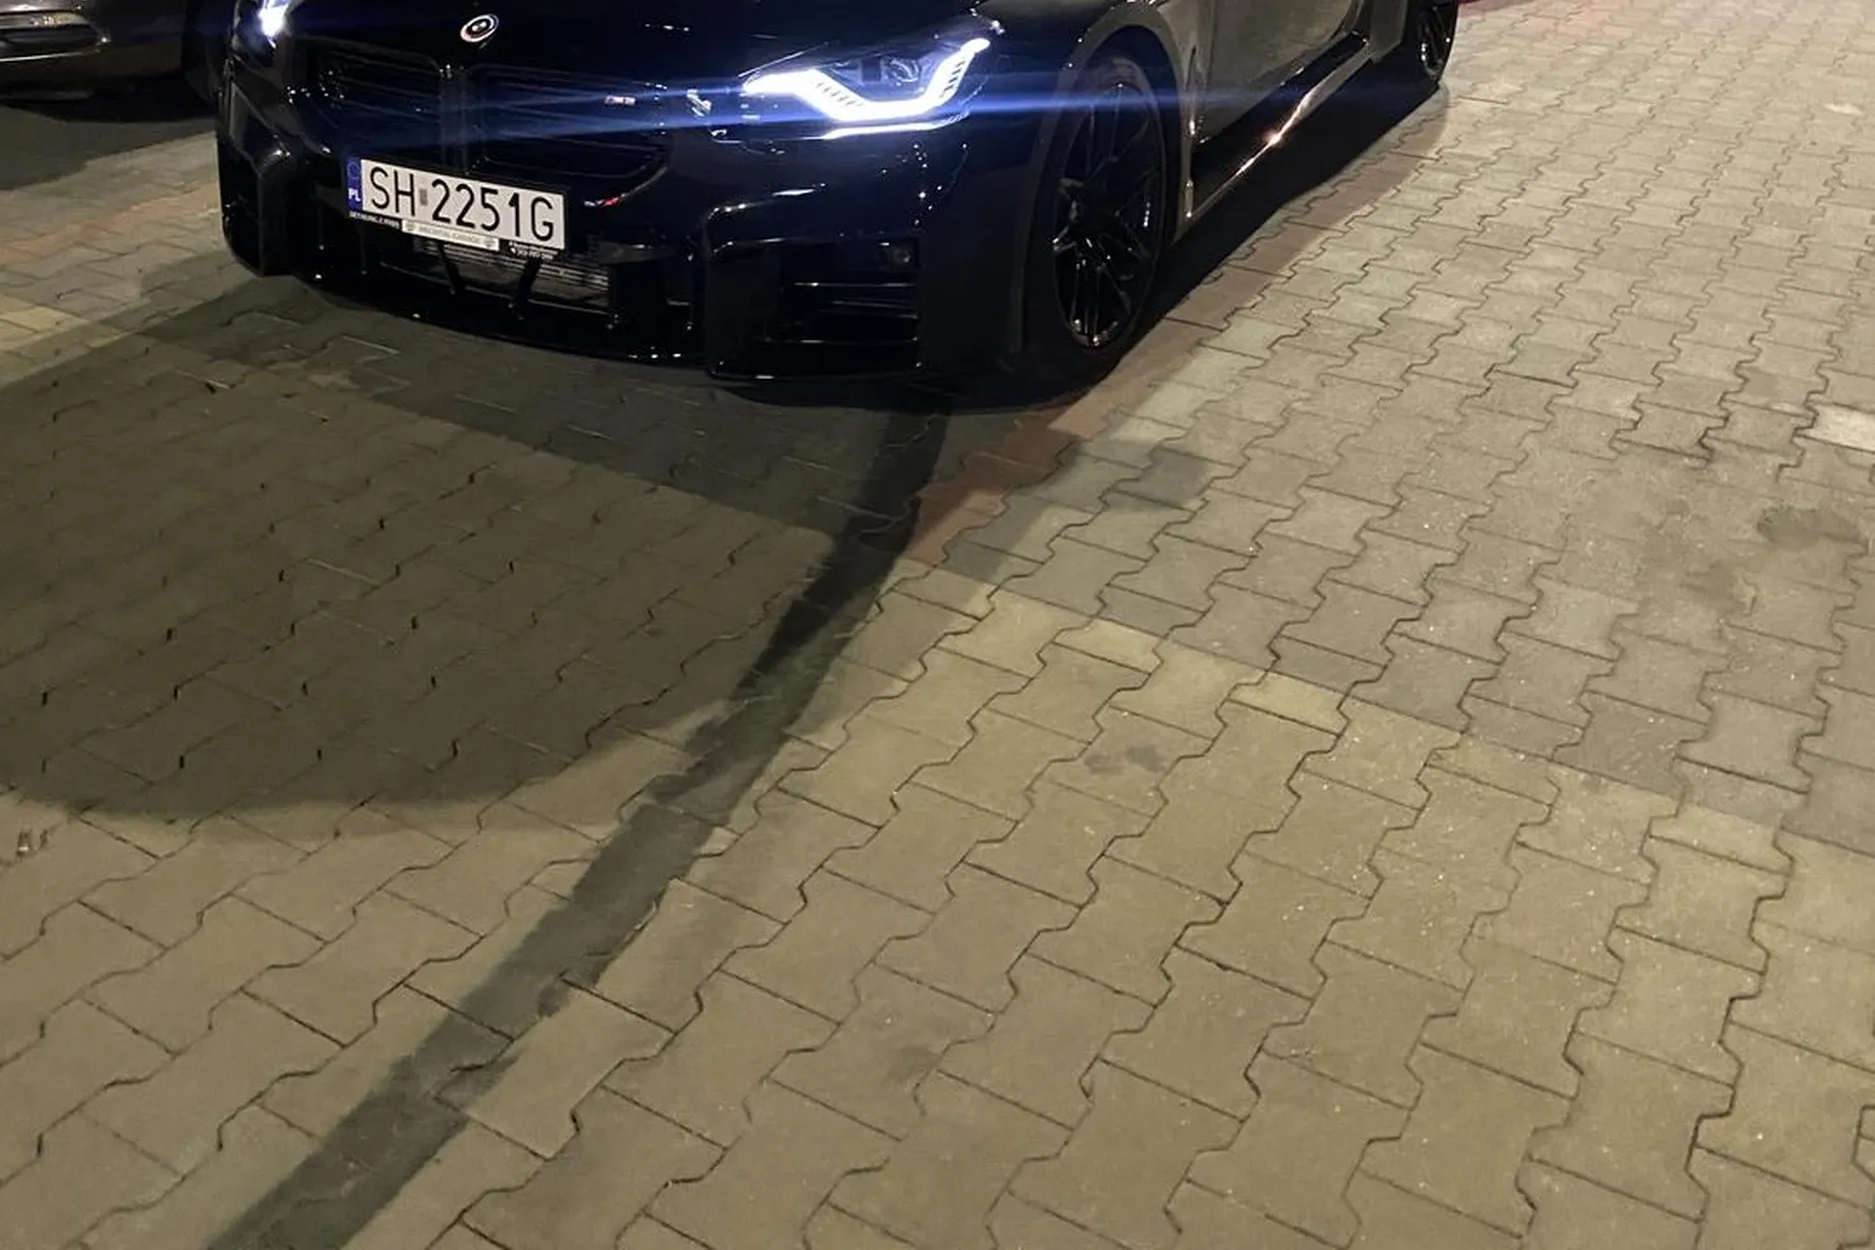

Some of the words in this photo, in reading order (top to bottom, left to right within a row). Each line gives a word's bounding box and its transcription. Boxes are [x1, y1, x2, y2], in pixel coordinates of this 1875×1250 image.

[348, 188, 361, 202] PL
[370, 166, 416, 217] SH
[431, 178, 554, 241] 2251G
